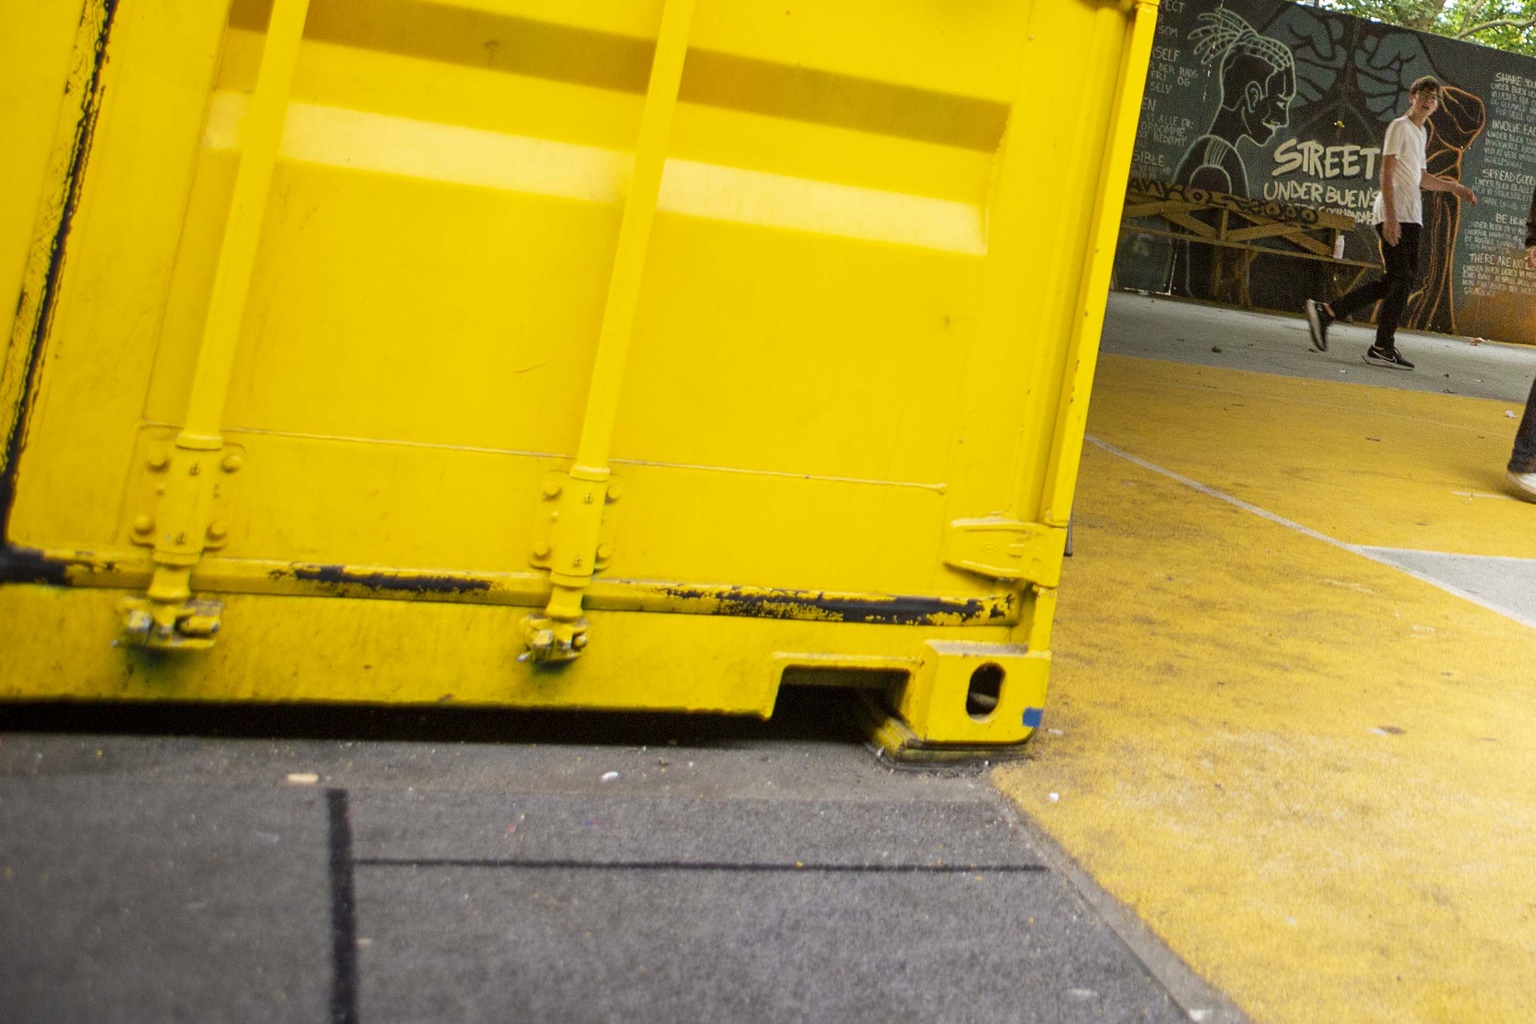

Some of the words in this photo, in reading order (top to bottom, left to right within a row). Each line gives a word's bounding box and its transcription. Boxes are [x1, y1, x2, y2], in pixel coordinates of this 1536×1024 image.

[1494, 72, 1522, 85] SHARE
[1272, 138, 1381, 180] STREET
[1482, 168, 1515, 182] SPREAD
[1263, 180, 1322, 203] UNDER
[1468, 253, 1496, 265] THERE
